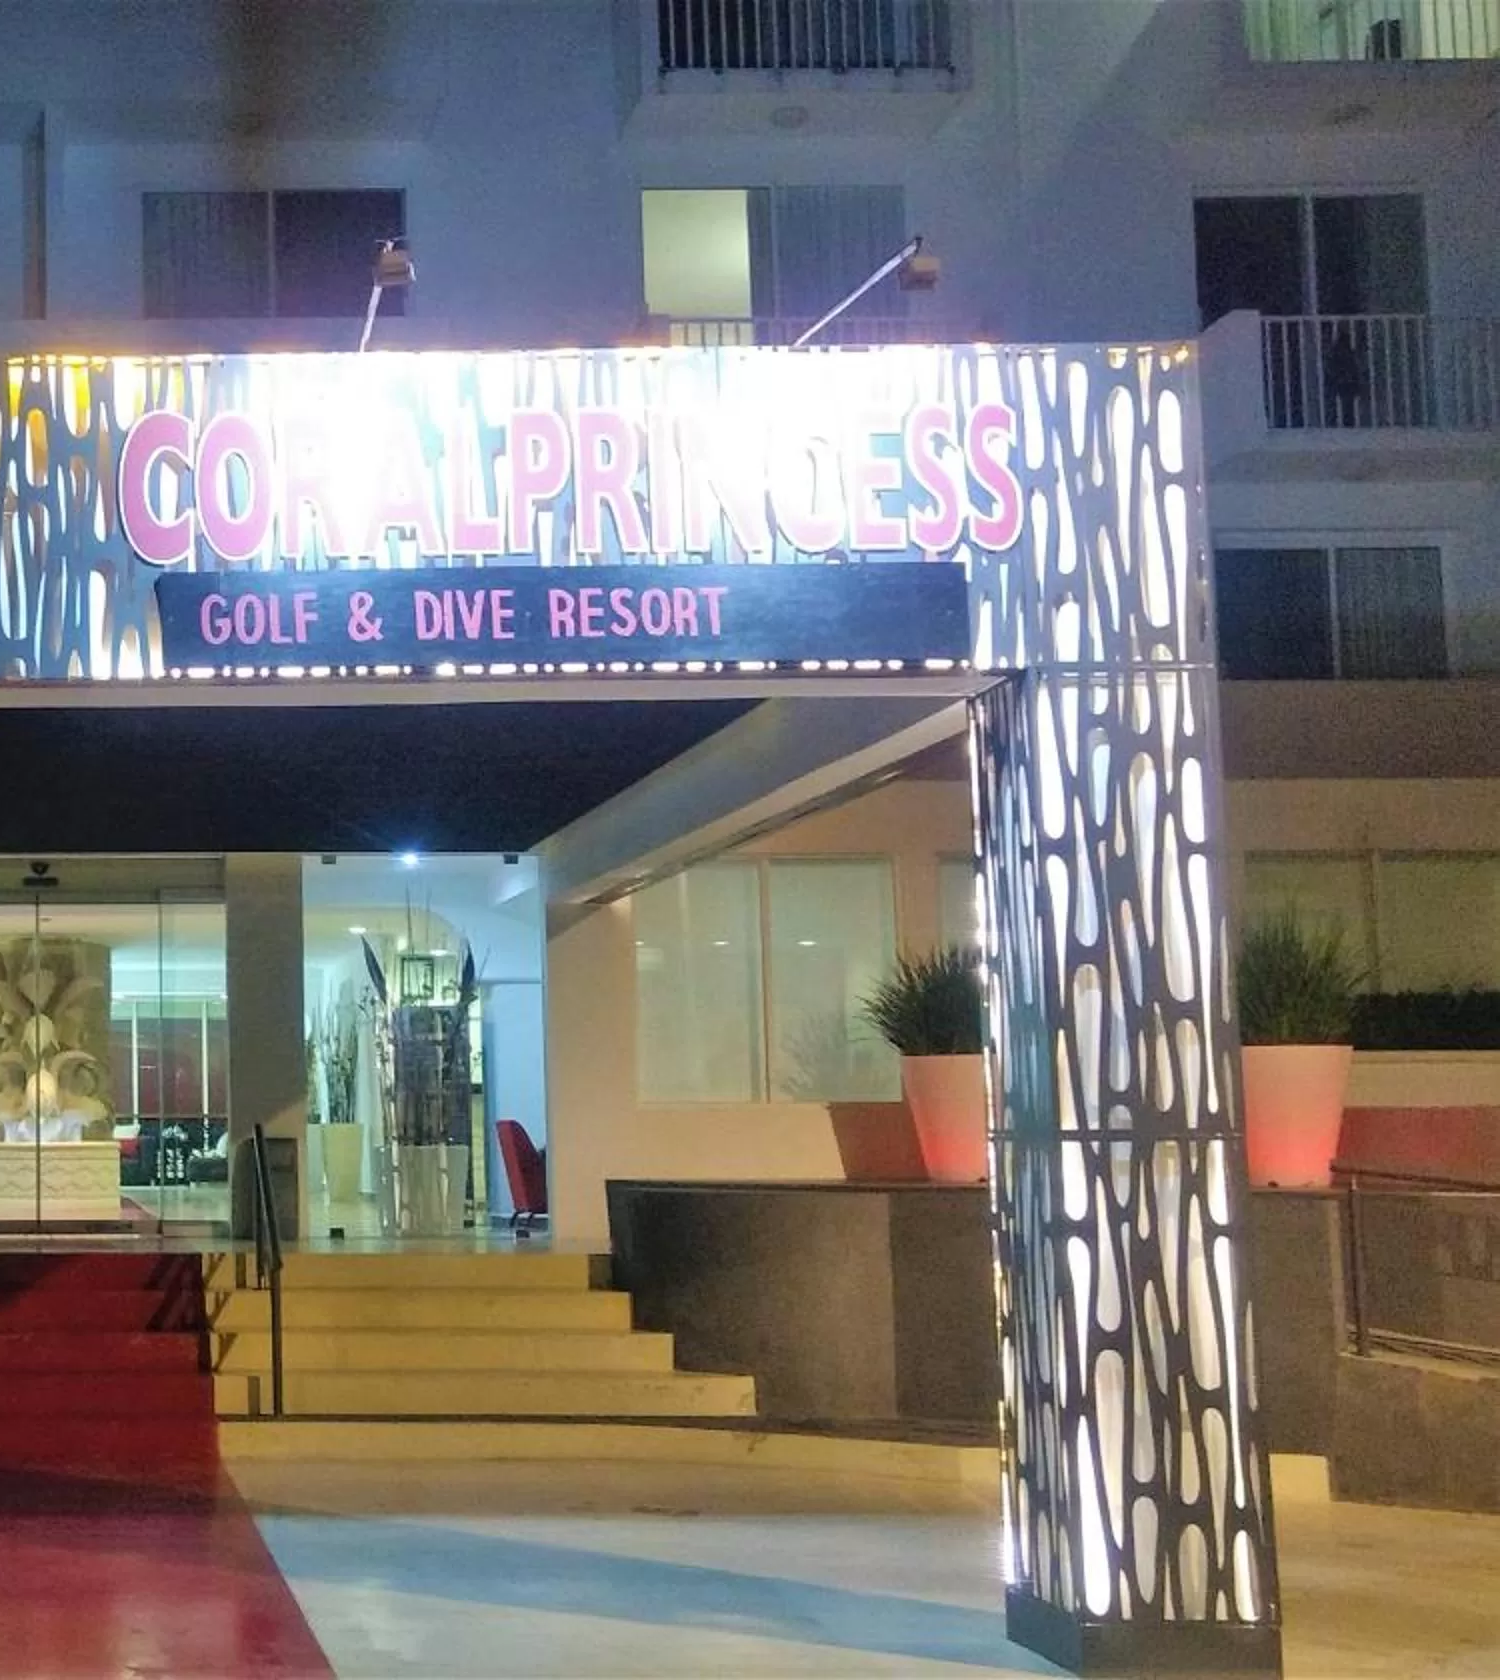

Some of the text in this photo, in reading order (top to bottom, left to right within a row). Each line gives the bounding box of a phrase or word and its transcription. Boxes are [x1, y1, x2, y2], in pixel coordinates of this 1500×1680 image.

[200, 586, 729, 645] GOLF & DIVE RESORT
